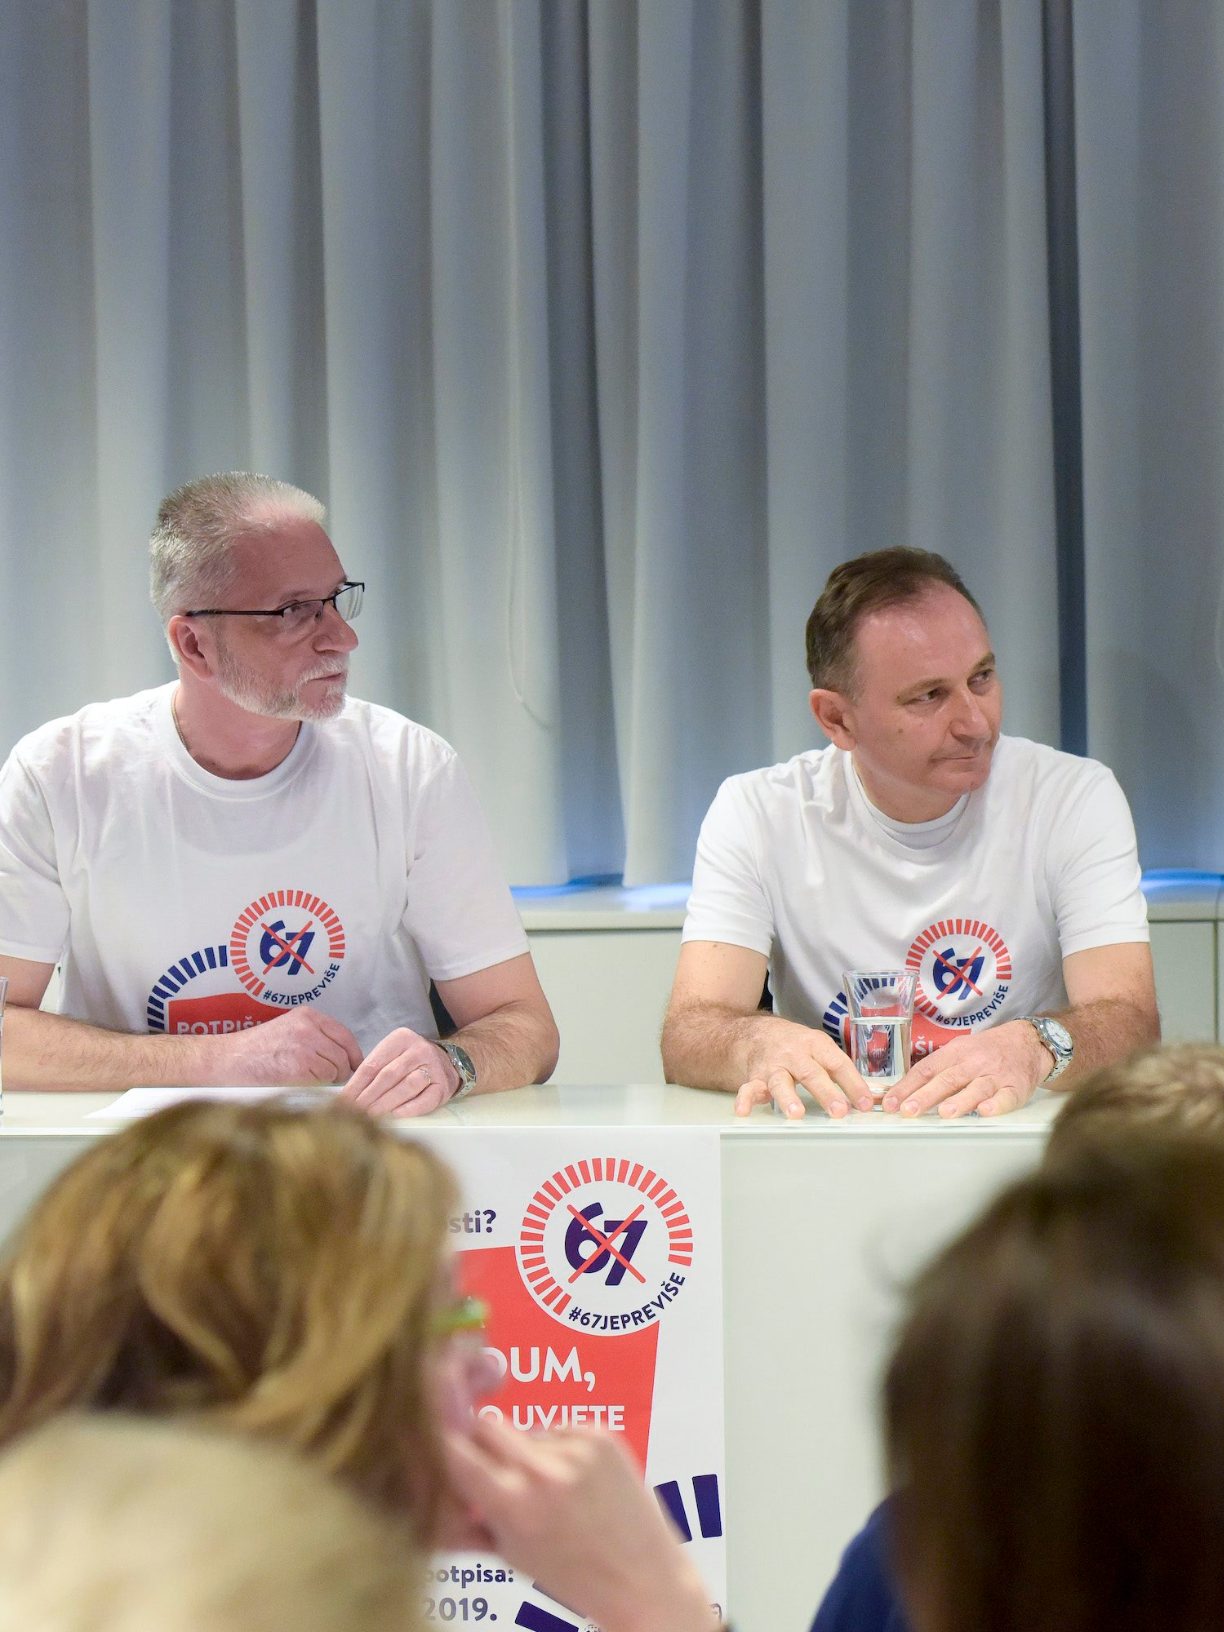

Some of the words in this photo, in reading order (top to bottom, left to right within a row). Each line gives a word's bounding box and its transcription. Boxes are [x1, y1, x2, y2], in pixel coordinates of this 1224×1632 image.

[260, 920, 315, 975] 67
[263, 963, 340, 1005] #67JEPREVIŠE
[933, 948, 985, 1000] 67
[936, 984, 1009, 1027] #67JEPREVIŠE
[565, 1202, 648, 1286] 67
[568, 1271, 686, 1330] #67JEPREVIŠE
[512, 1405, 625, 1431] UVJETE
